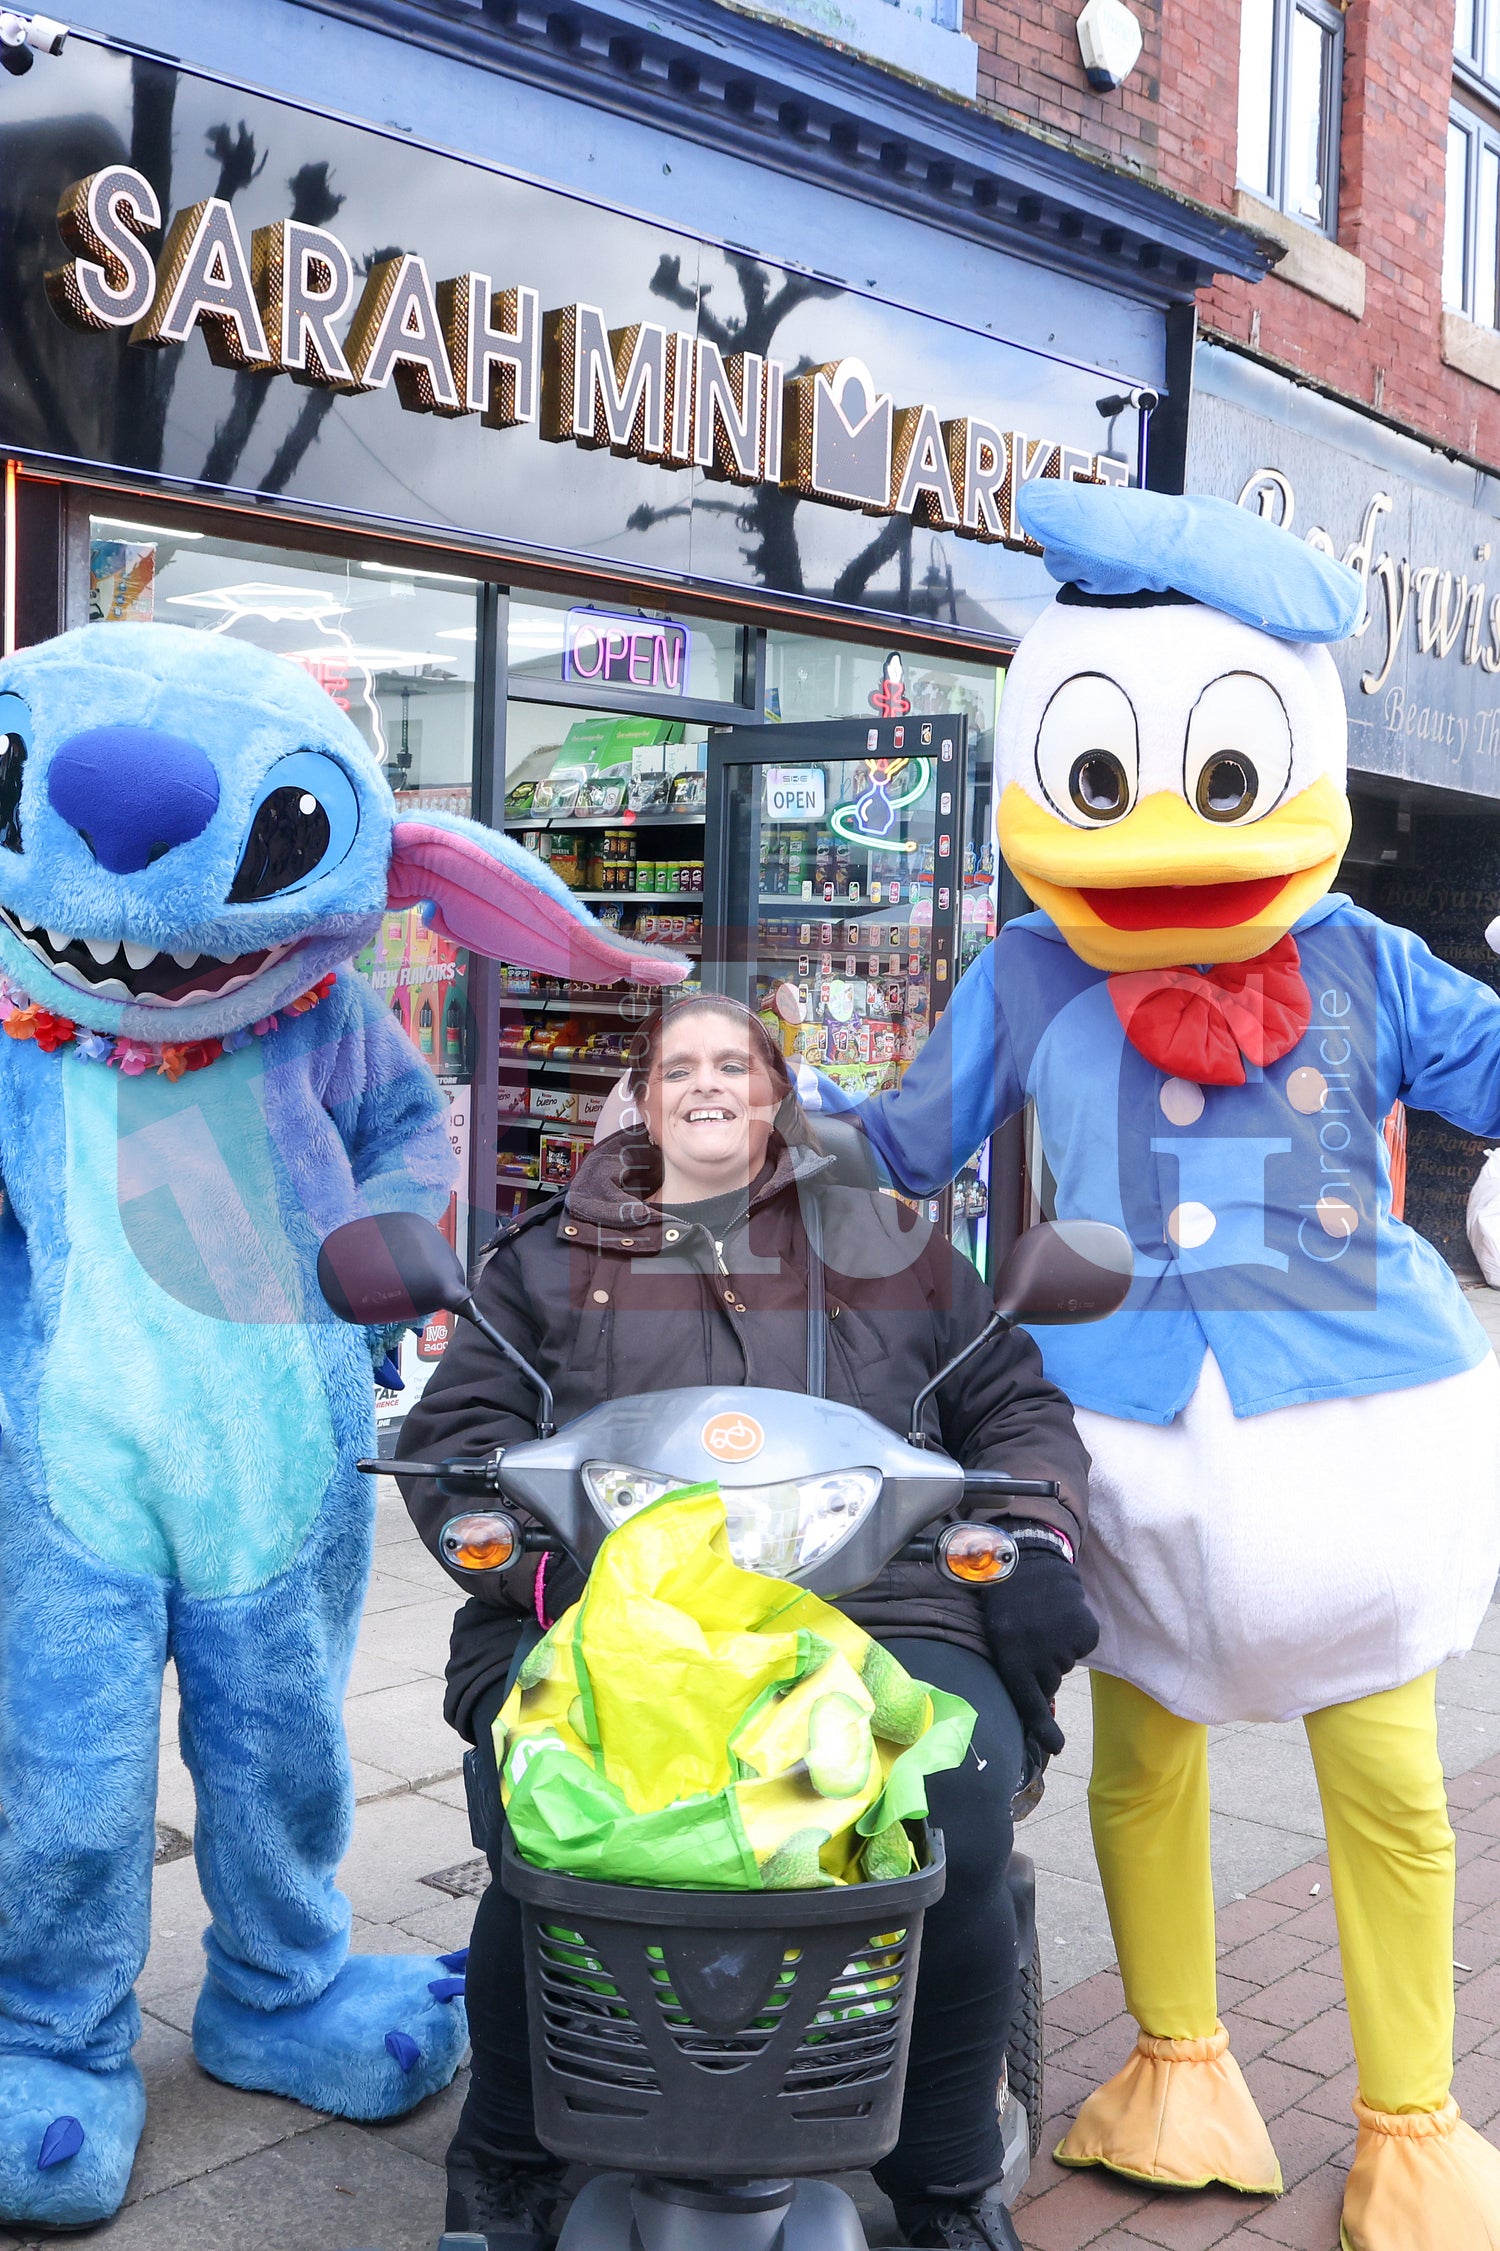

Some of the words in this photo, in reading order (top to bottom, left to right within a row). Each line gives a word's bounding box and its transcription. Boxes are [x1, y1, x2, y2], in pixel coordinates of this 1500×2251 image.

[72, 164, 539, 424] SARAH
[572, 301, 784, 483] MINI
[570, 622, 683, 691] OPEN
[1384, 686, 1469, 765] Beauty
[773, 791, 816, 809] OPEN
[400, 962, 457, 988] FLAVOURS
[535, 1097, 558, 1108] bueno
[1434, 1132, 1487, 1157] Range
